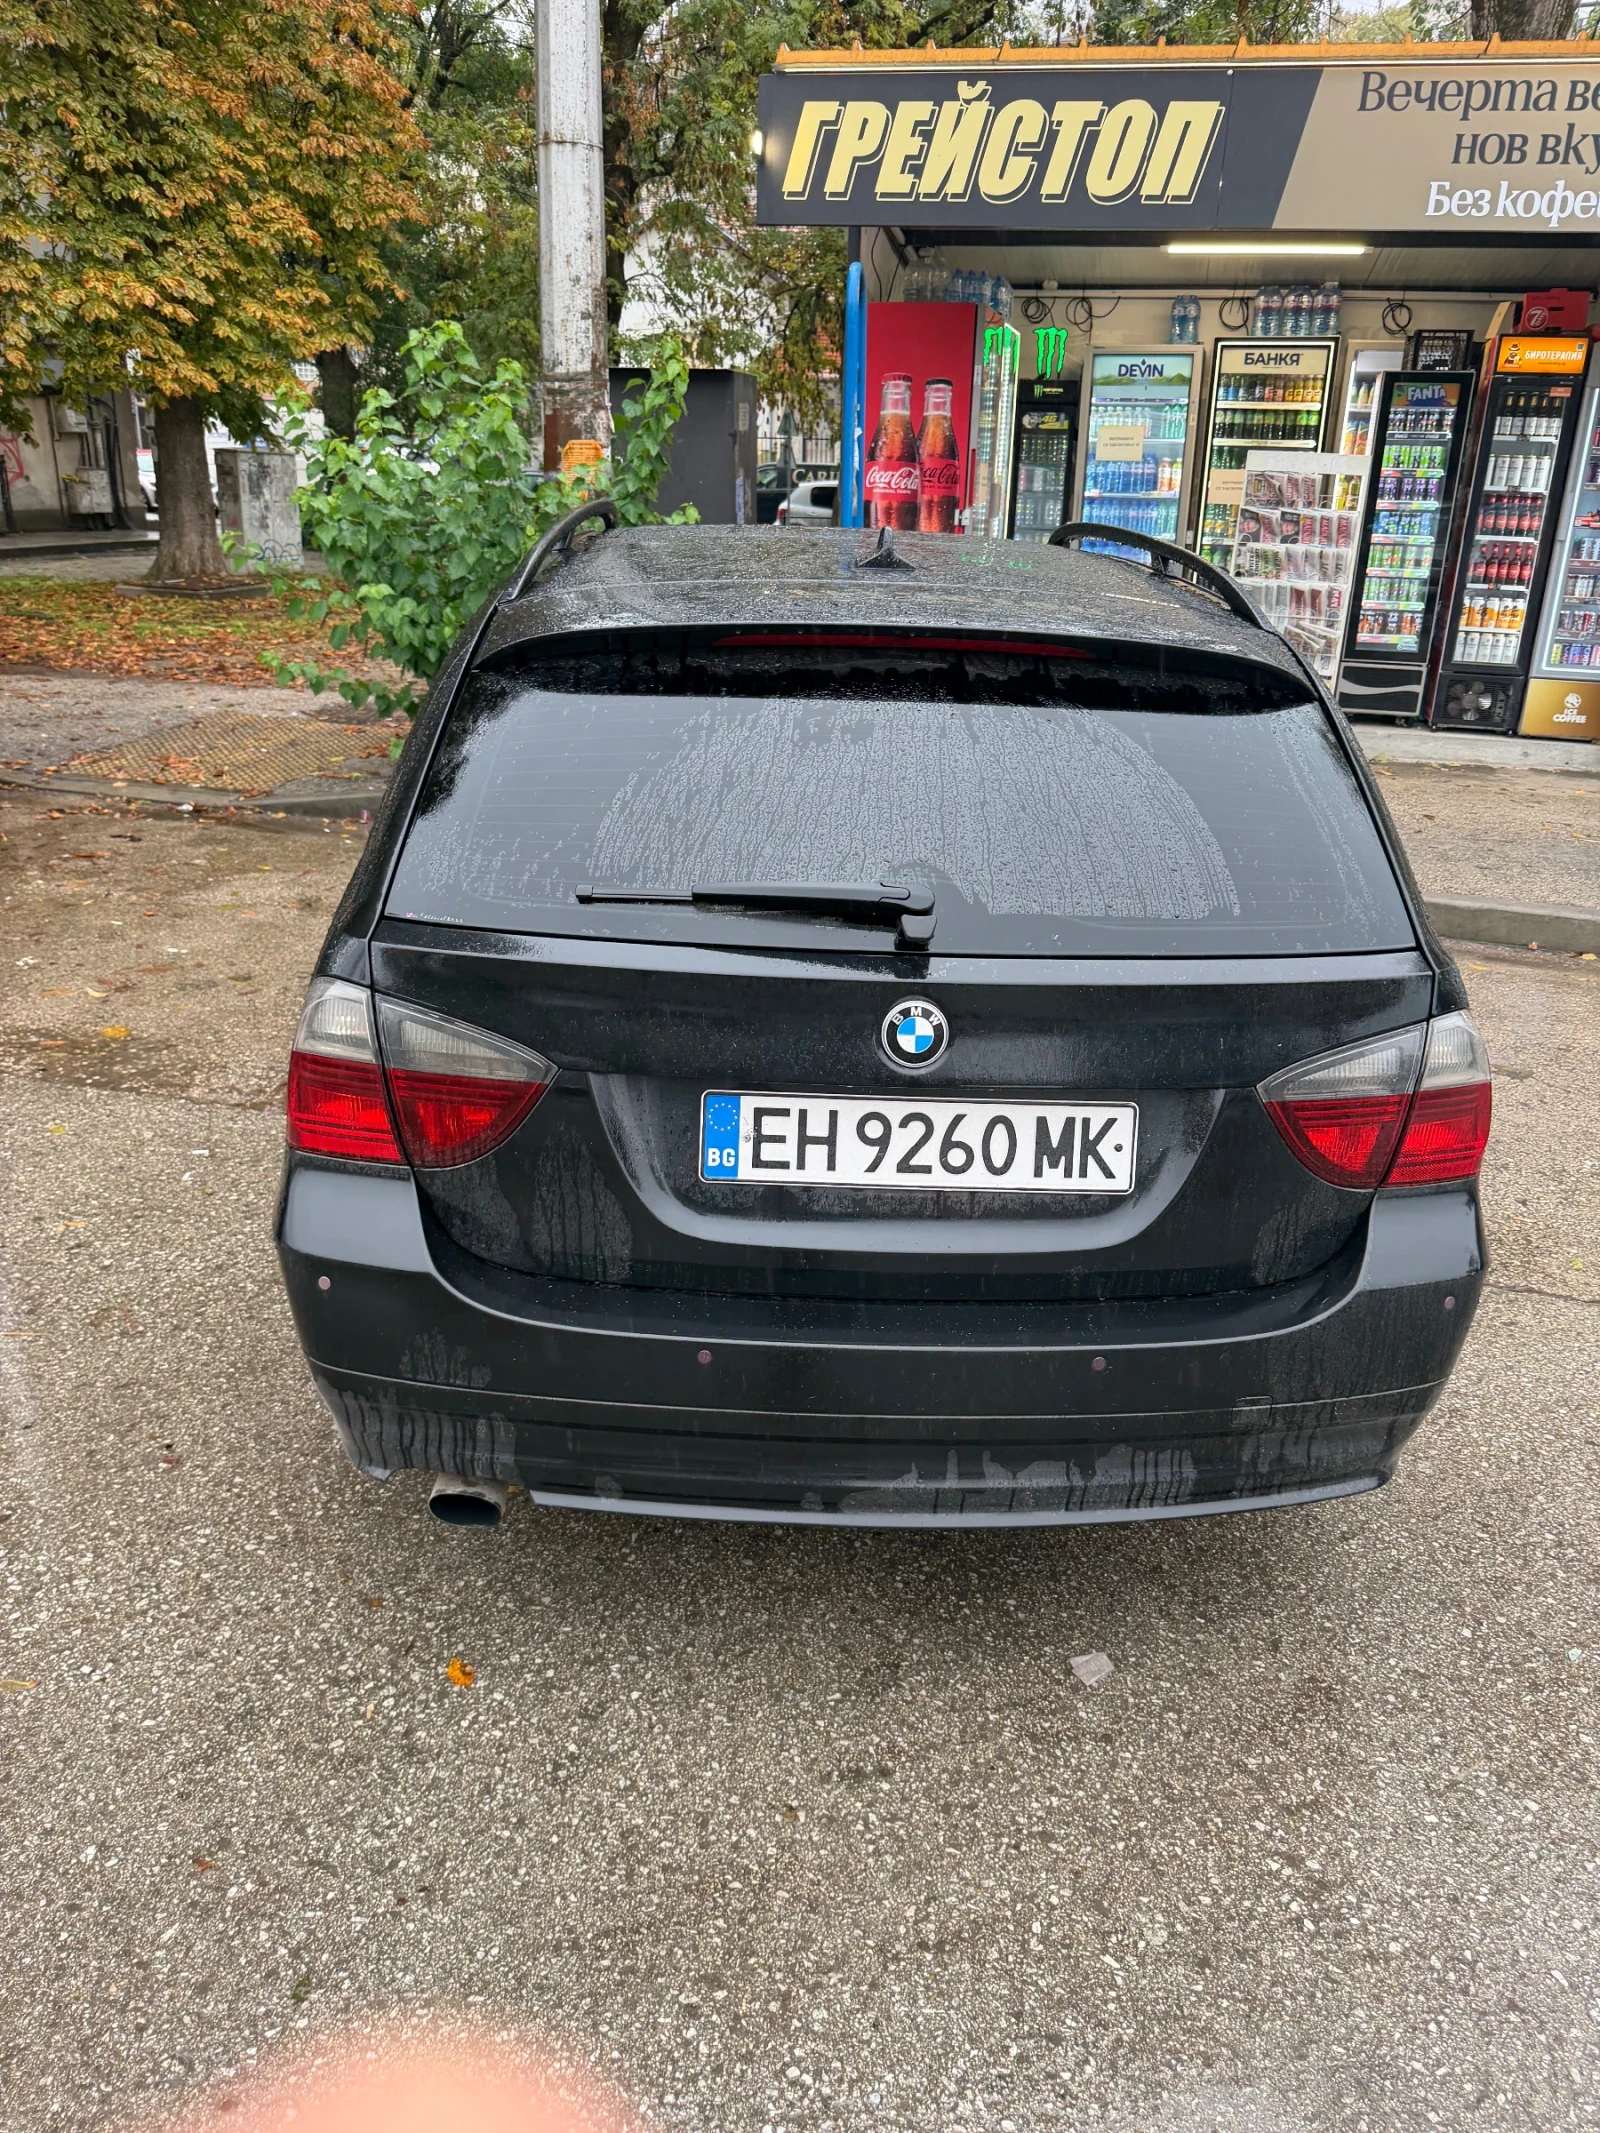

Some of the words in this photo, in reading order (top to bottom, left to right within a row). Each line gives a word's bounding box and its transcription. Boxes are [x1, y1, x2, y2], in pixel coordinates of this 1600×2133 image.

[1356, 71, 1558, 121] Вечерта
[782, 80, 1226, 205] ГРЕЙСТОП
[1451, 133, 1529, 164] нов
[1425, 180, 1492, 216] Без
[1494, 179, 1600, 227] кофе
[1244, 352, 1301, 366] БАНКЯ
[1525, 350, 1583, 361] БИРОТЕРАПИЯ
[1117, 363, 1164, 378] DEVIN
[1407, 384, 1447, 401] FANTA
[866, 466, 919, 489] Coca-Cola
[1552, 714, 1587, 723] COFFEE
[891, 1006, 941, 1026] BMW
[751, 1106, 839, 1172] EH
[856, 1111, 1018, 1176] 9260
[1033, 1116, 1119, 1180] MK
[707, 1147, 736, 1167] BG
